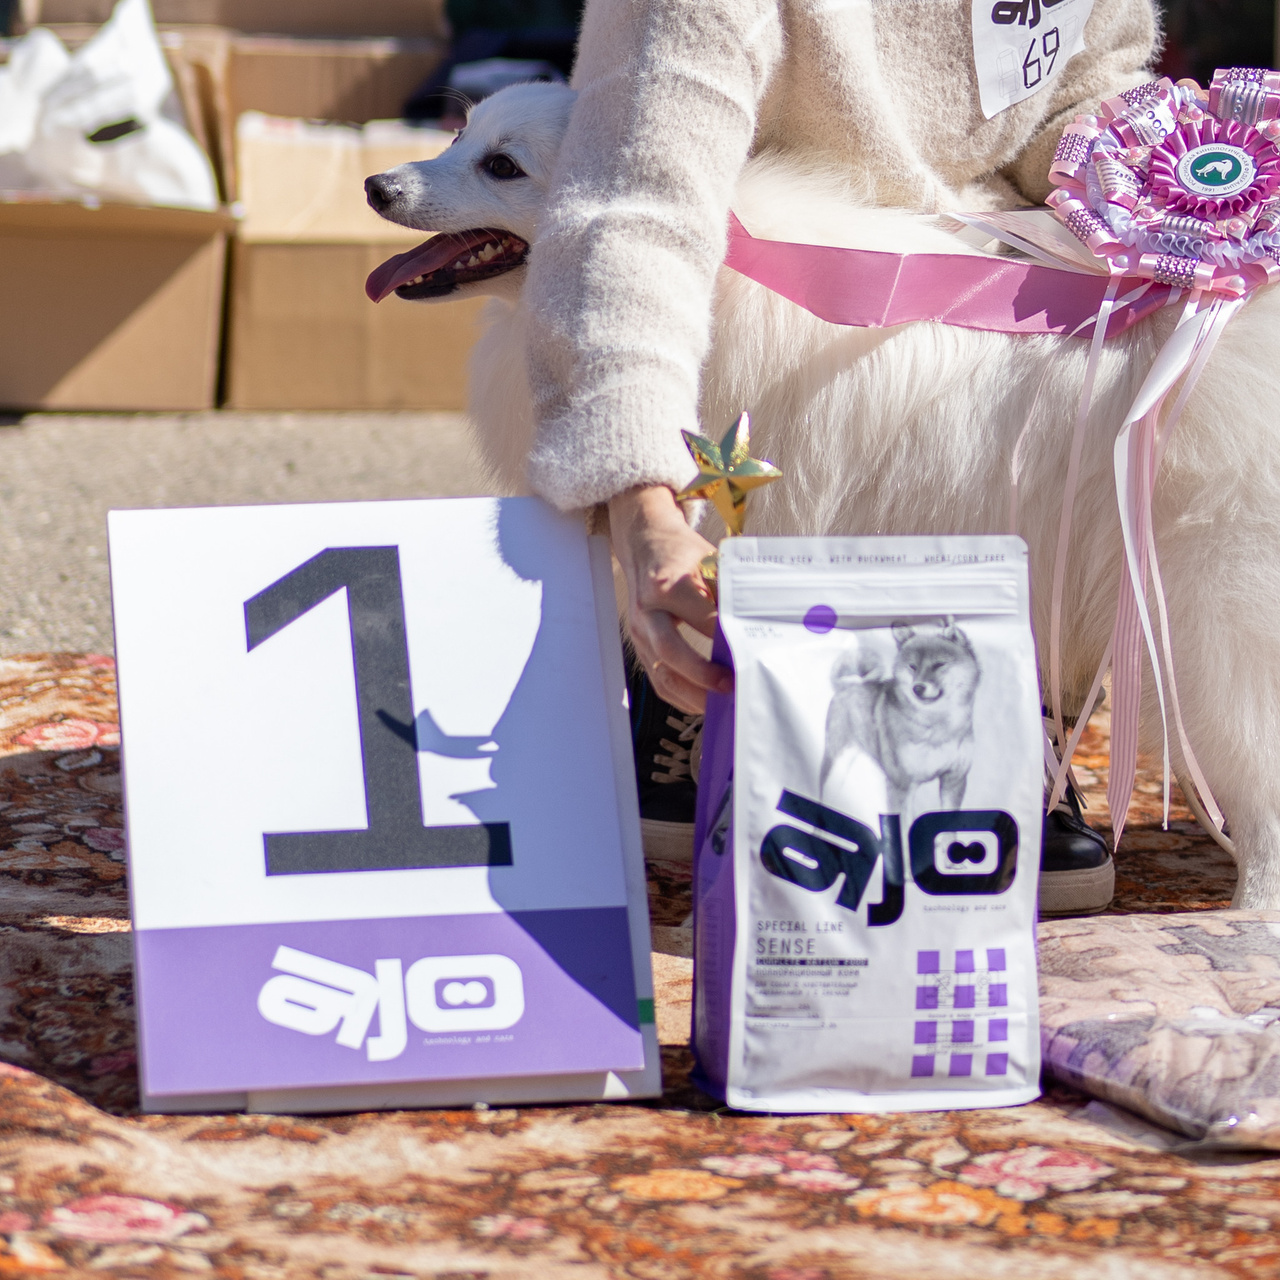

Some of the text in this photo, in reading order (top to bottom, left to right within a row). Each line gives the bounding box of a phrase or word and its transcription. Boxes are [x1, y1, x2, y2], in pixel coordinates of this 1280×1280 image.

[1022, 26, 1060, 89] 69
[243, 545, 514, 876] 1
[757, 921, 844, 933] SPECIAL LINE
[757, 938, 816, 955] SENSE
